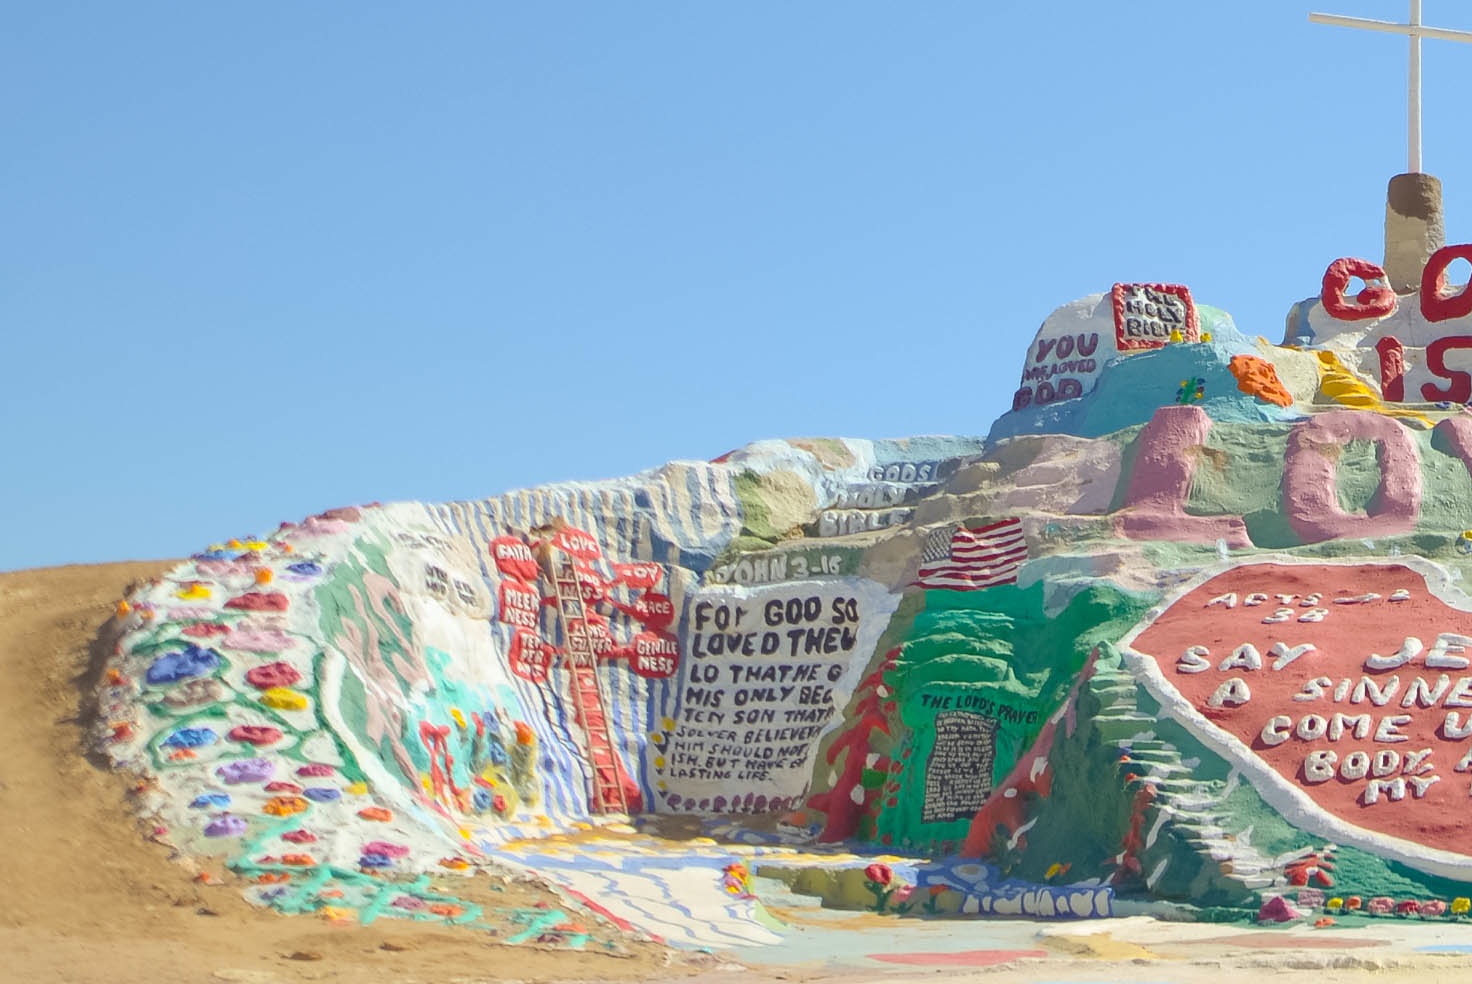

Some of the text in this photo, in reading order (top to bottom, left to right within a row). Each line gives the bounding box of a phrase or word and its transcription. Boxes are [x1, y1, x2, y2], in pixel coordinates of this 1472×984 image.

[1126, 300, 1181, 323] HOLY
[1036, 333, 1098, 363] YOU
[1013, 378, 1082, 412] GOD
[499, 543, 533, 562] FAITH
[560, 532, 598, 553] LOVE
[714, 554, 788, 584] JOHN
[764, 596, 822, 626] GOD
[831, 597, 860, 624] SO
[1204, 592, 1324, 609] ACTS
[504, 606, 537, 628] NESS
[692, 631, 780, 658] LOVED
[636, 655, 675, 674] NESS
[1176, 641, 1318, 674] SAY
[729, 664, 793, 684] THAT
[792, 663, 822, 683] HE
[685, 687, 725, 707] HIS
[734, 686, 795, 706] ONLY
[921, 693, 953, 709] THE
[1206, 677, 1252, 708] A
[683, 708, 725, 725] TEN
[732, 708, 775, 724] SON
[1260, 711, 1413, 747] COME
[675, 742, 705, 752] HIM
[708, 743, 774, 760] SHOULD
[705, 756, 741, 769] BUT
[670, 767, 732, 780] LASTING
[1364, 774, 1441, 805] MY
